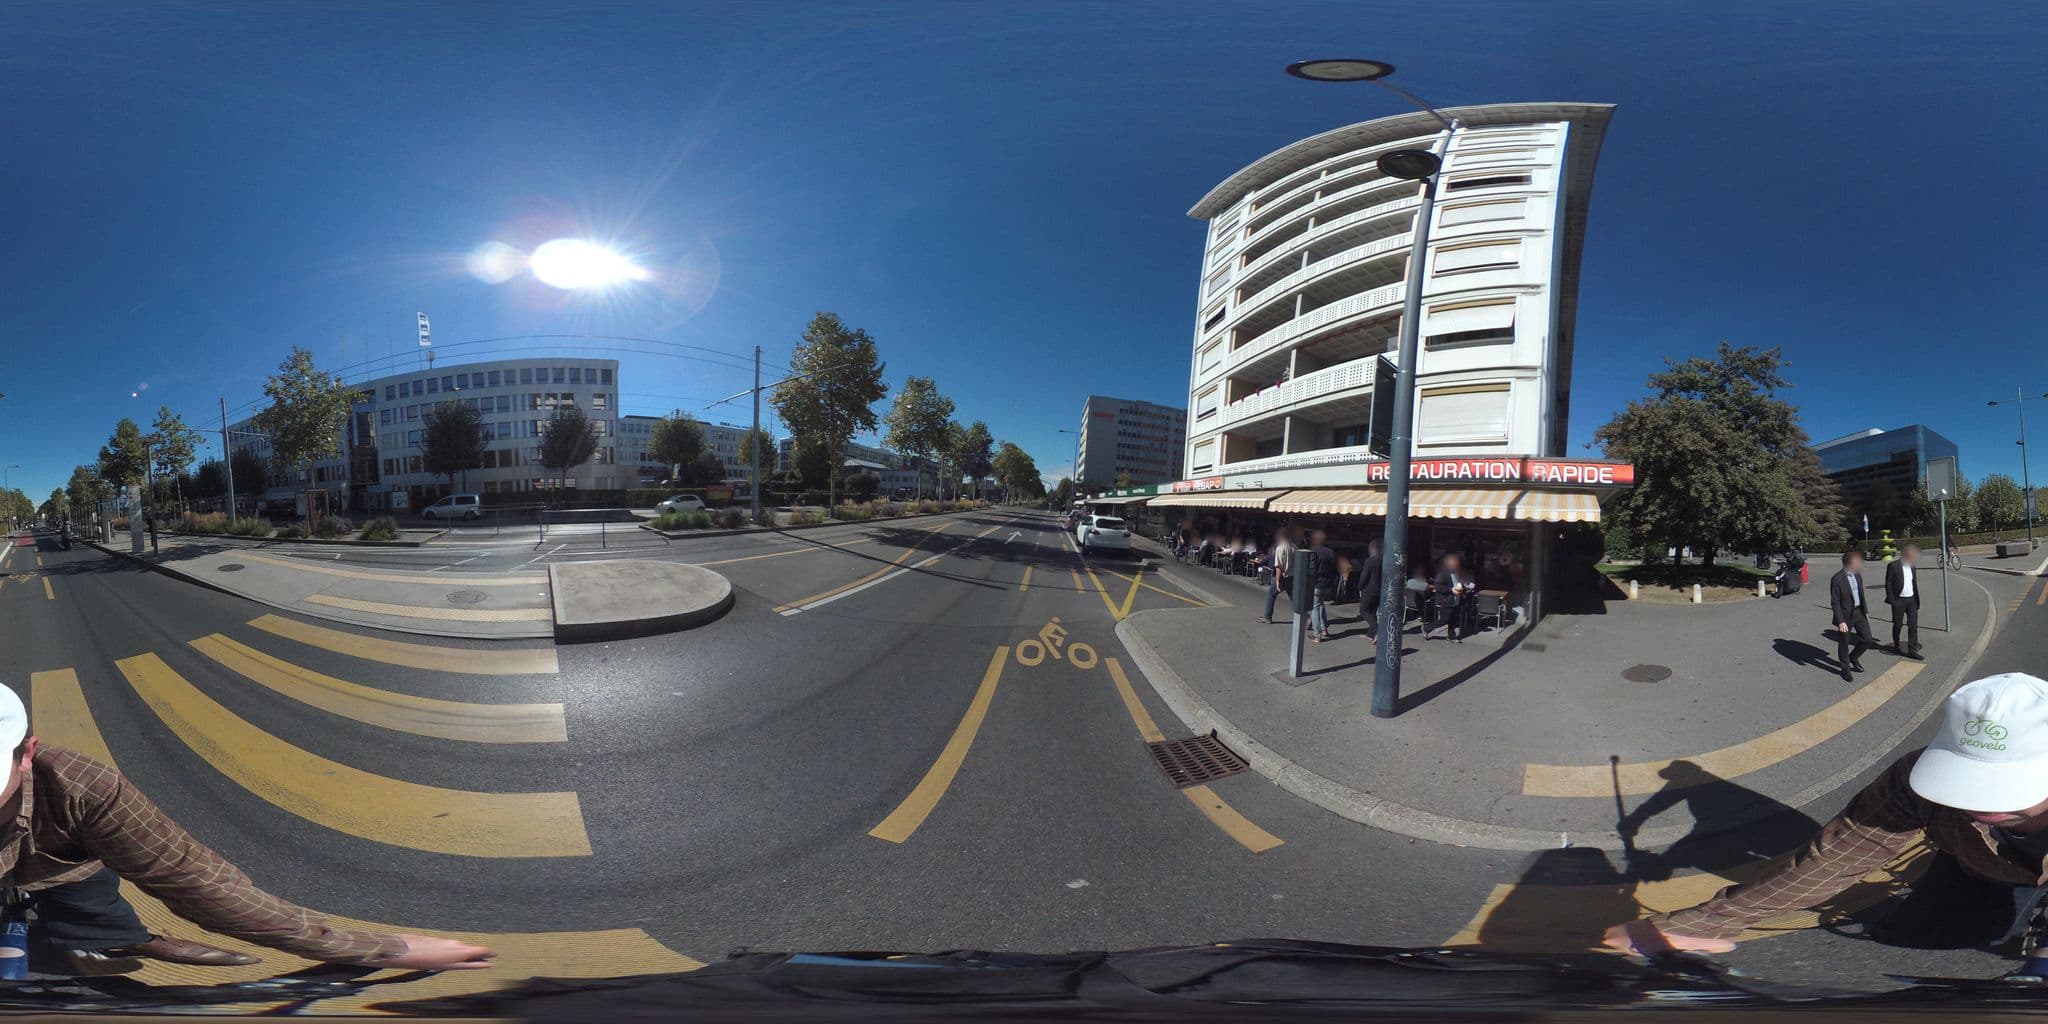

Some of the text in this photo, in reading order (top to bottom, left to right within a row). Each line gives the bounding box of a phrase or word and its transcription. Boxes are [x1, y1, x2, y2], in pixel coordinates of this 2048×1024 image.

[1371, 462, 1614, 484] RETAURATION RAPIDE
[1959, 737, 2006, 751] geovelo
